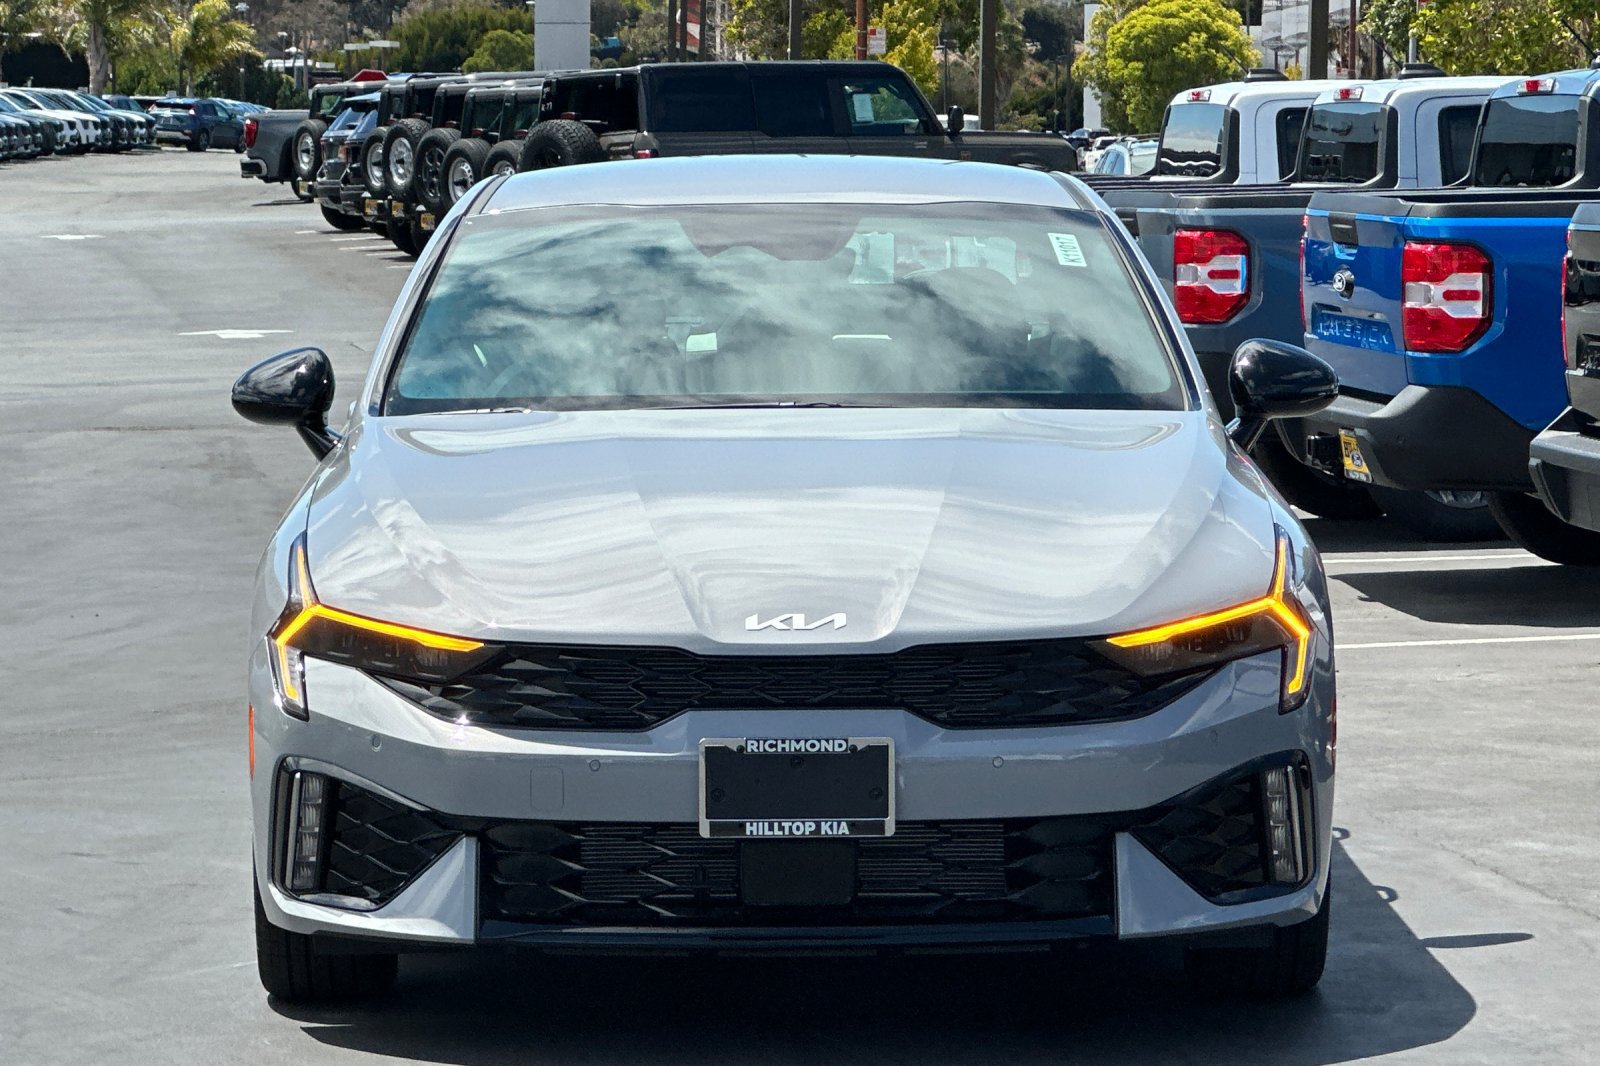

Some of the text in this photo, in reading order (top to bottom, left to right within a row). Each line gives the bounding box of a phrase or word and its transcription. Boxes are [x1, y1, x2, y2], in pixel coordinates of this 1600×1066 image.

[745, 613, 847, 631] KIA
[747, 740, 847, 752] RICHMOND
[746, 822, 850, 835] HILLTOP KIA
